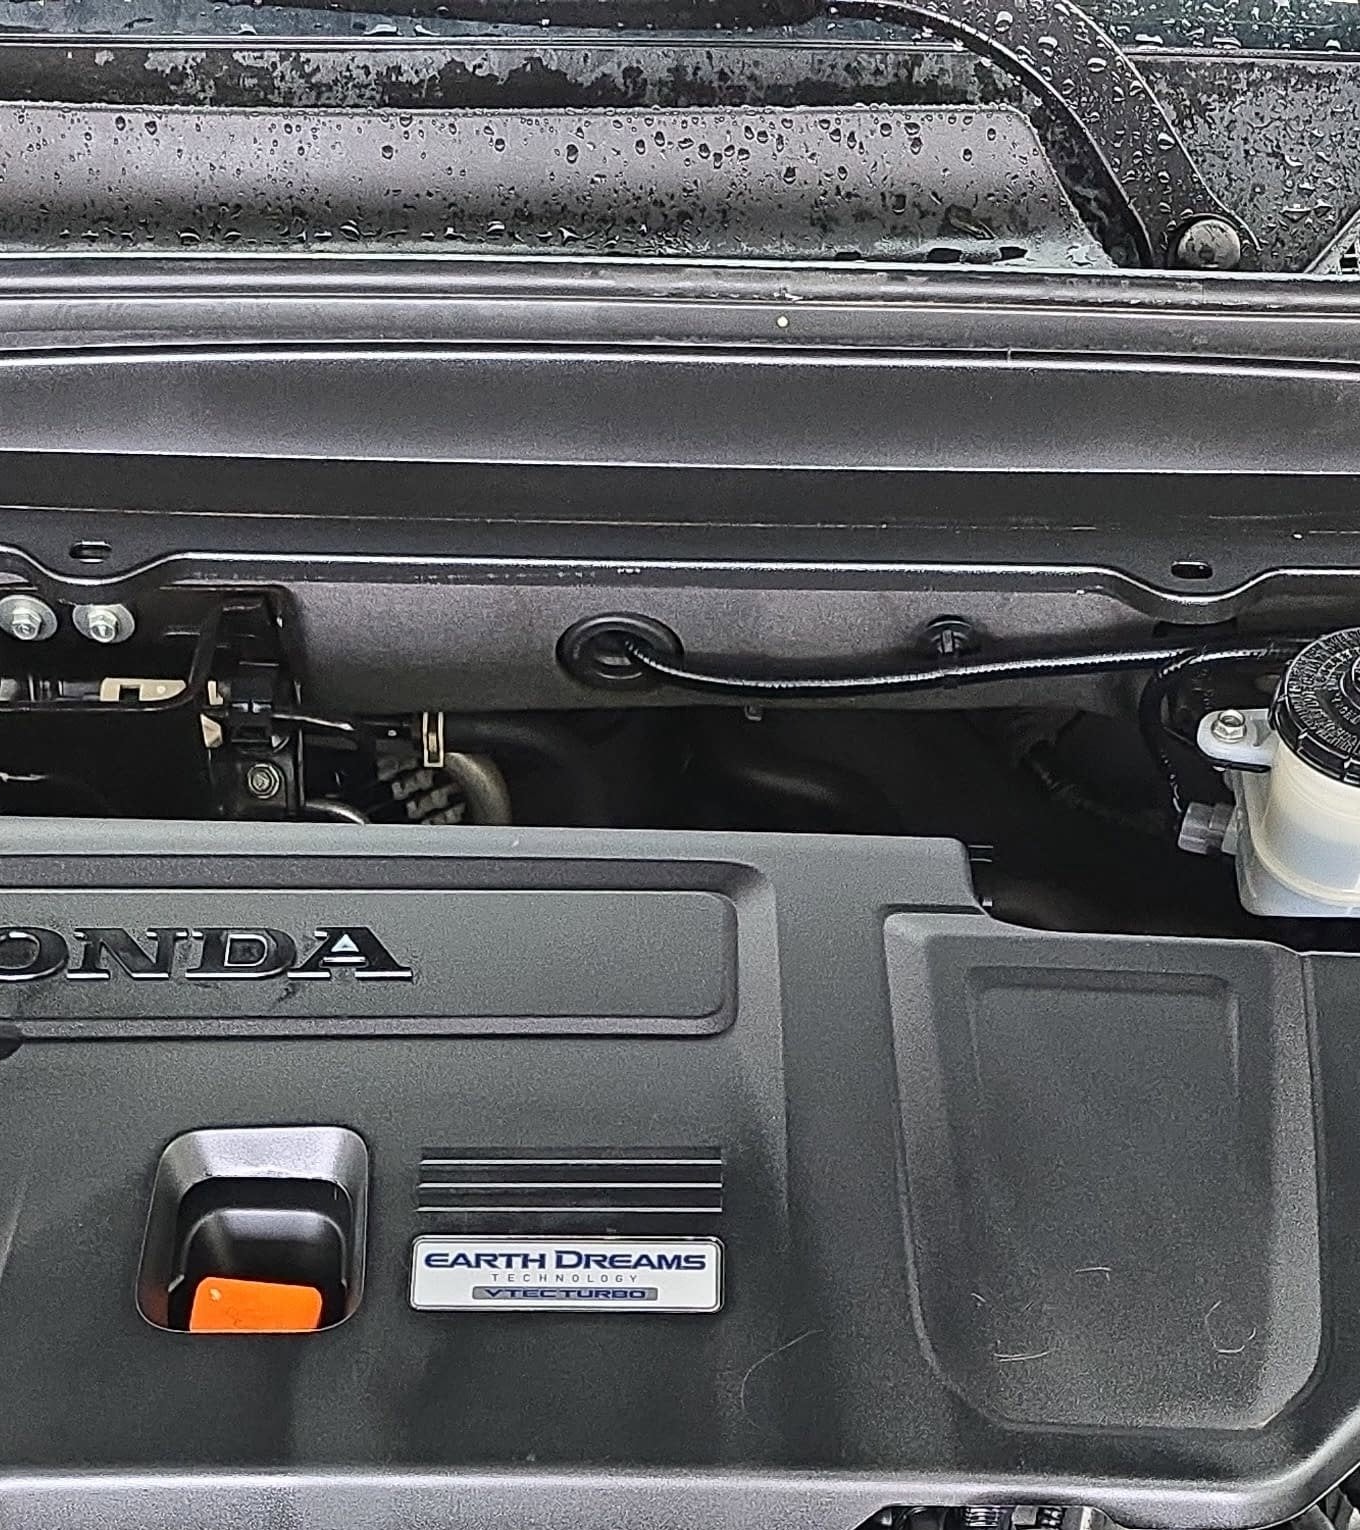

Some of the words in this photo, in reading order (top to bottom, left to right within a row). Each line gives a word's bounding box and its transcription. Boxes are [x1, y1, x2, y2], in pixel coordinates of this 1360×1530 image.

[424, 1252, 546, 1270] EARTH
[554, 1250, 707, 1271] DREAMS
[491, 1273, 638, 1283] TECHNOLOGY
